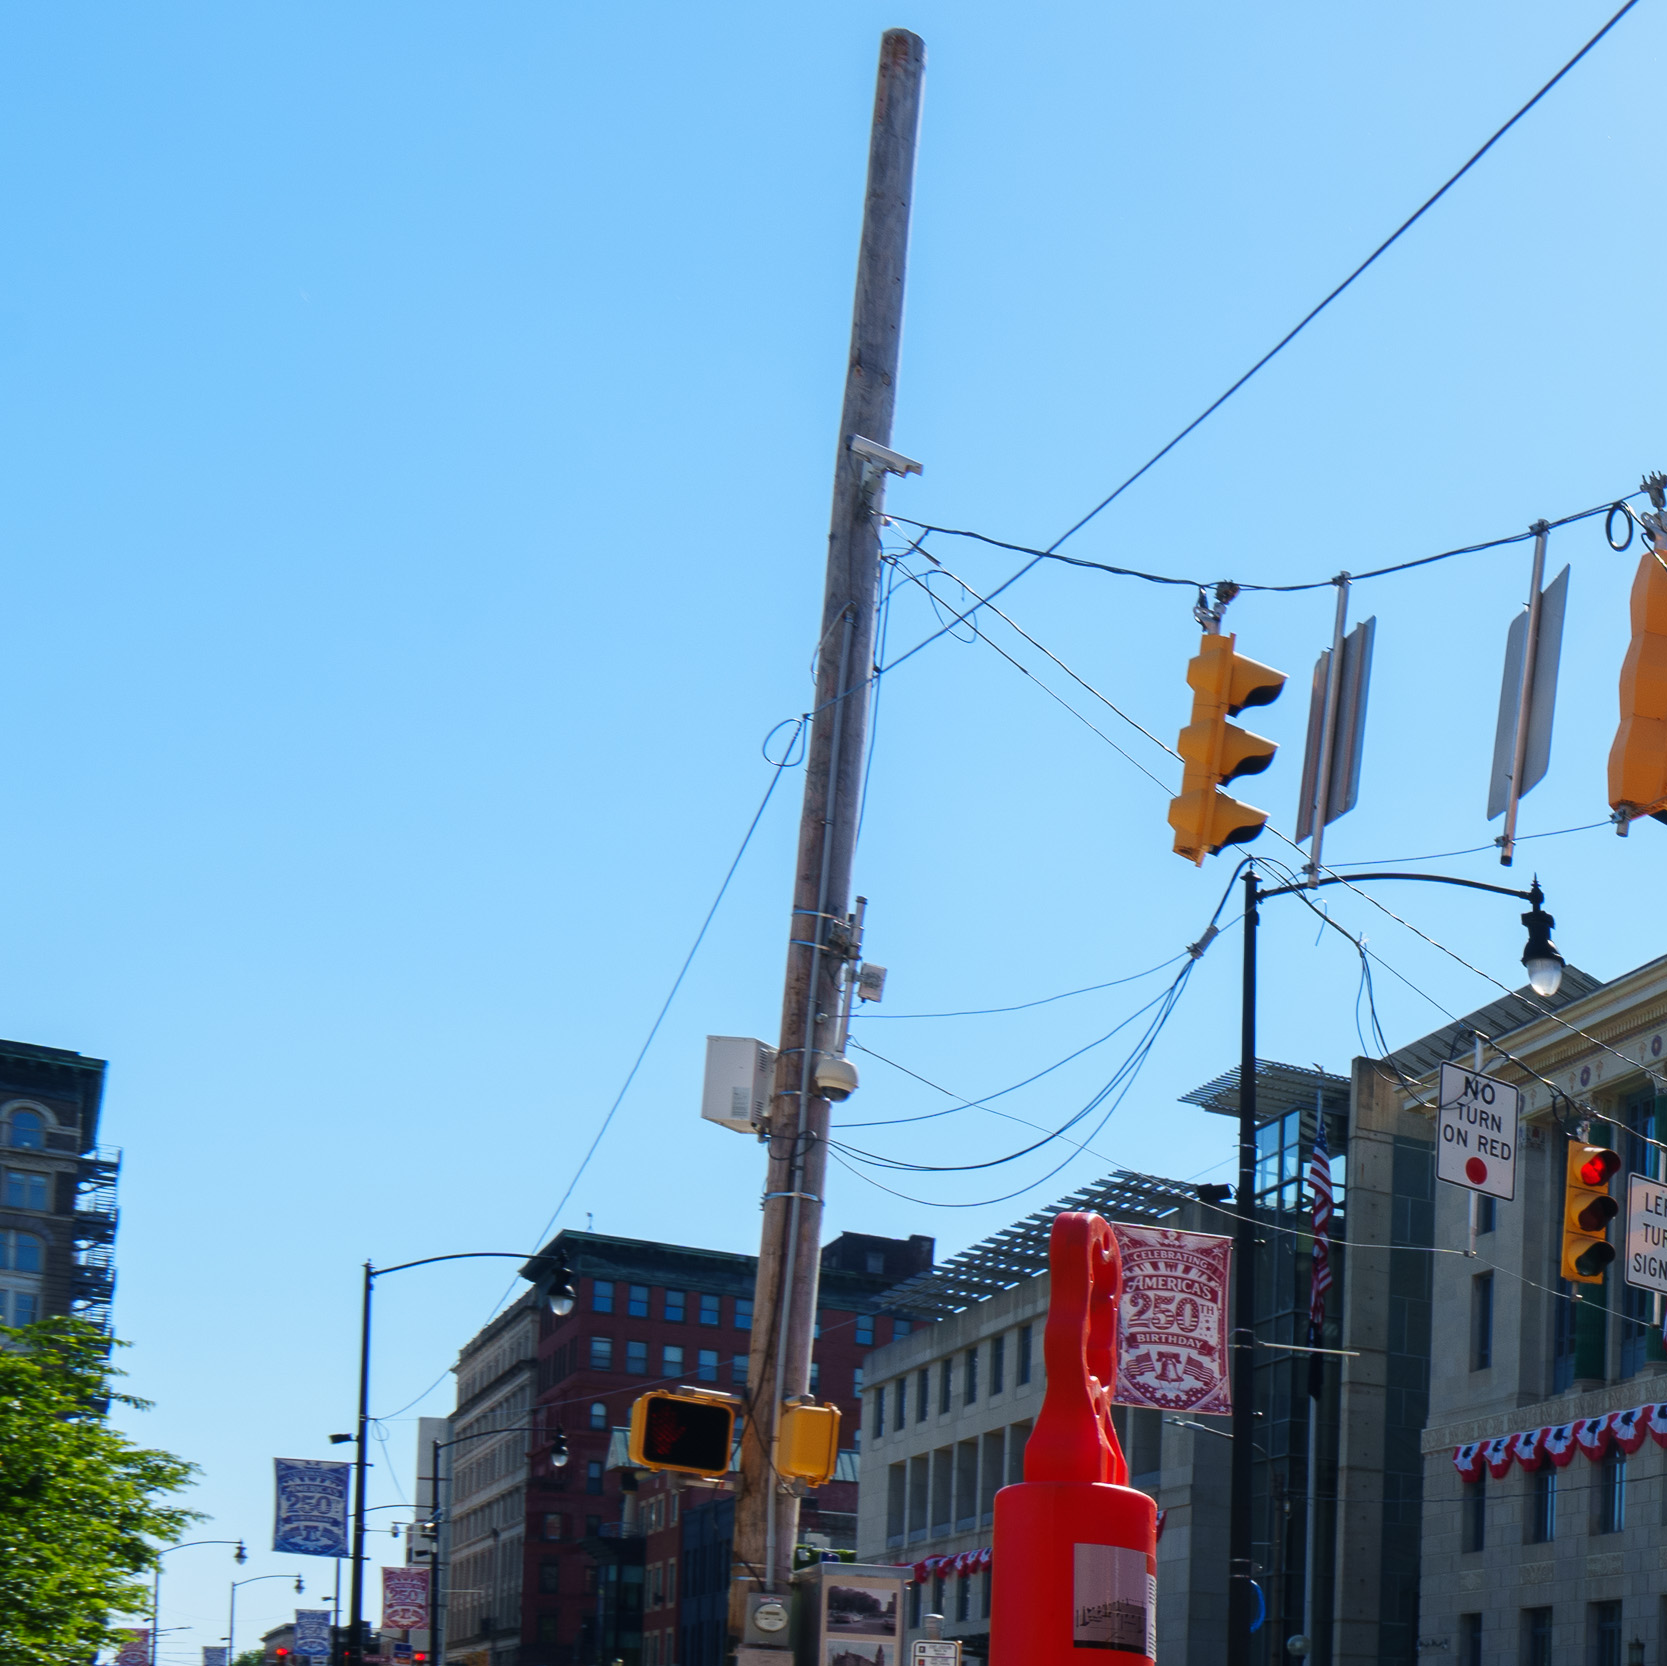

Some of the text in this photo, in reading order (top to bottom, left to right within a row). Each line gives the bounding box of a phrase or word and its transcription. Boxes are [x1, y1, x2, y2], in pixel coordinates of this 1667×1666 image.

[1464, 1076, 1496, 1105] NO
[1456, 1101, 1502, 1134] TURN
[1443, 1123, 1512, 1161] ON RED
[1132, 1250, 1208, 1269] CELEBRATING
[1126, 1276, 1212, 1300] AMERICA'S
[1136, 1333, 1204, 1349] BIRTHDAY
